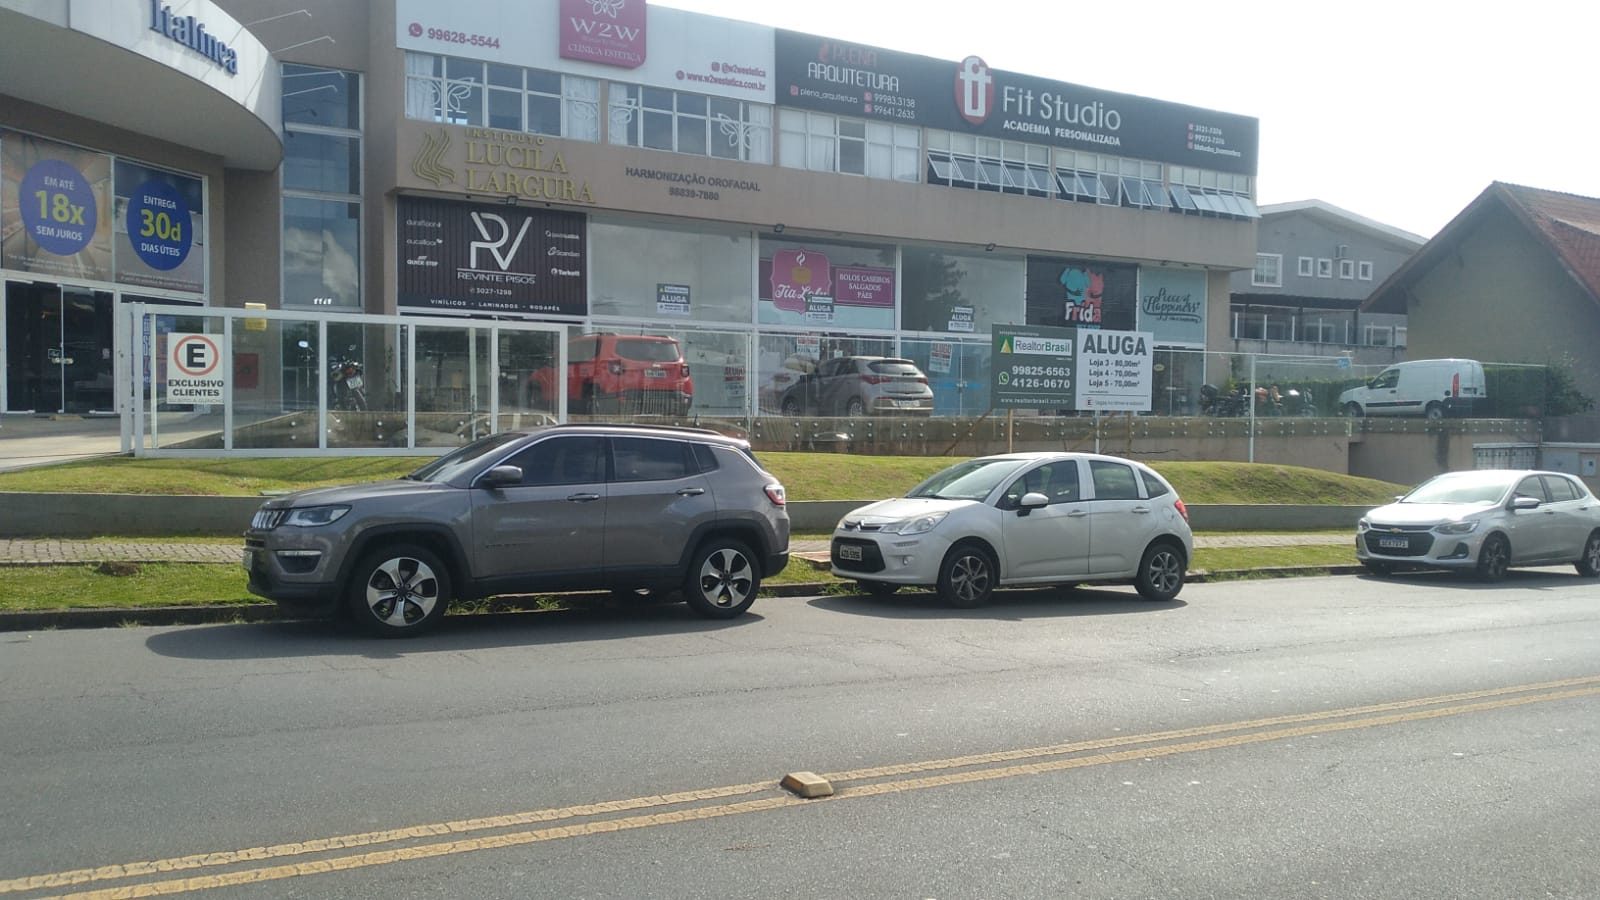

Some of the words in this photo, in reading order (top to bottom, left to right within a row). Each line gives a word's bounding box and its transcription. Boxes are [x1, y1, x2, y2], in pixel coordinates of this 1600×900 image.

[570, 17, 640, 41] W2W
[427, 27, 500, 49] 99628-5544
[808, 62, 899, 92] ARQUITETURA
[1003, 86, 1034, 117] Fit
[1040, 93, 1121, 131] Studio
[465, 128, 545, 145] INSTITUTO
[1003, 119, 1051, 136] ACADEMIA
[1054, 127, 1121, 146] PERSONALIZADA
[465, 141, 568, 174] LUCILA
[44, 176, 58, 187] EM
[466, 168, 596, 204] LARGURA
[625, 167, 705, 186] HARMONIZAÇÃO
[708, 176, 761, 192] OROFACIAL
[35, 190, 85, 225] 18x
[143, 194, 177, 209] ENTREGA
[140, 209, 181, 241] 30d
[36, 226, 54, 237] SEM
[56, 229, 83, 241] JUROS
[141, 243, 159, 254] DIAS
[160, 245, 180, 257] ÚTEIS
[457, 272, 503, 283] REVINTE
[505, 275, 536, 285] PISOS
[775, 284, 797, 298] Tia
[848, 283, 881, 292] SALGADOS
[1065, 301, 1102, 323] Frida
[1015, 340, 1071, 353] RealtorBrasil
[1083, 334, 1147, 356] ALUGA
[187, 344, 206, 368] E
[1089, 359, 1104, 367] Loja
[1012, 365, 1071, 377] 99825-6563
[1089, 369, 1104, 378] Loja
[168, 379, 224, 388] EXCLUSIVO
[1011, 378, 1071, 389] 4126-0670
[1088, 379, 1104, 388] Loja
[172, 388, 220, 397] CLIENTES
